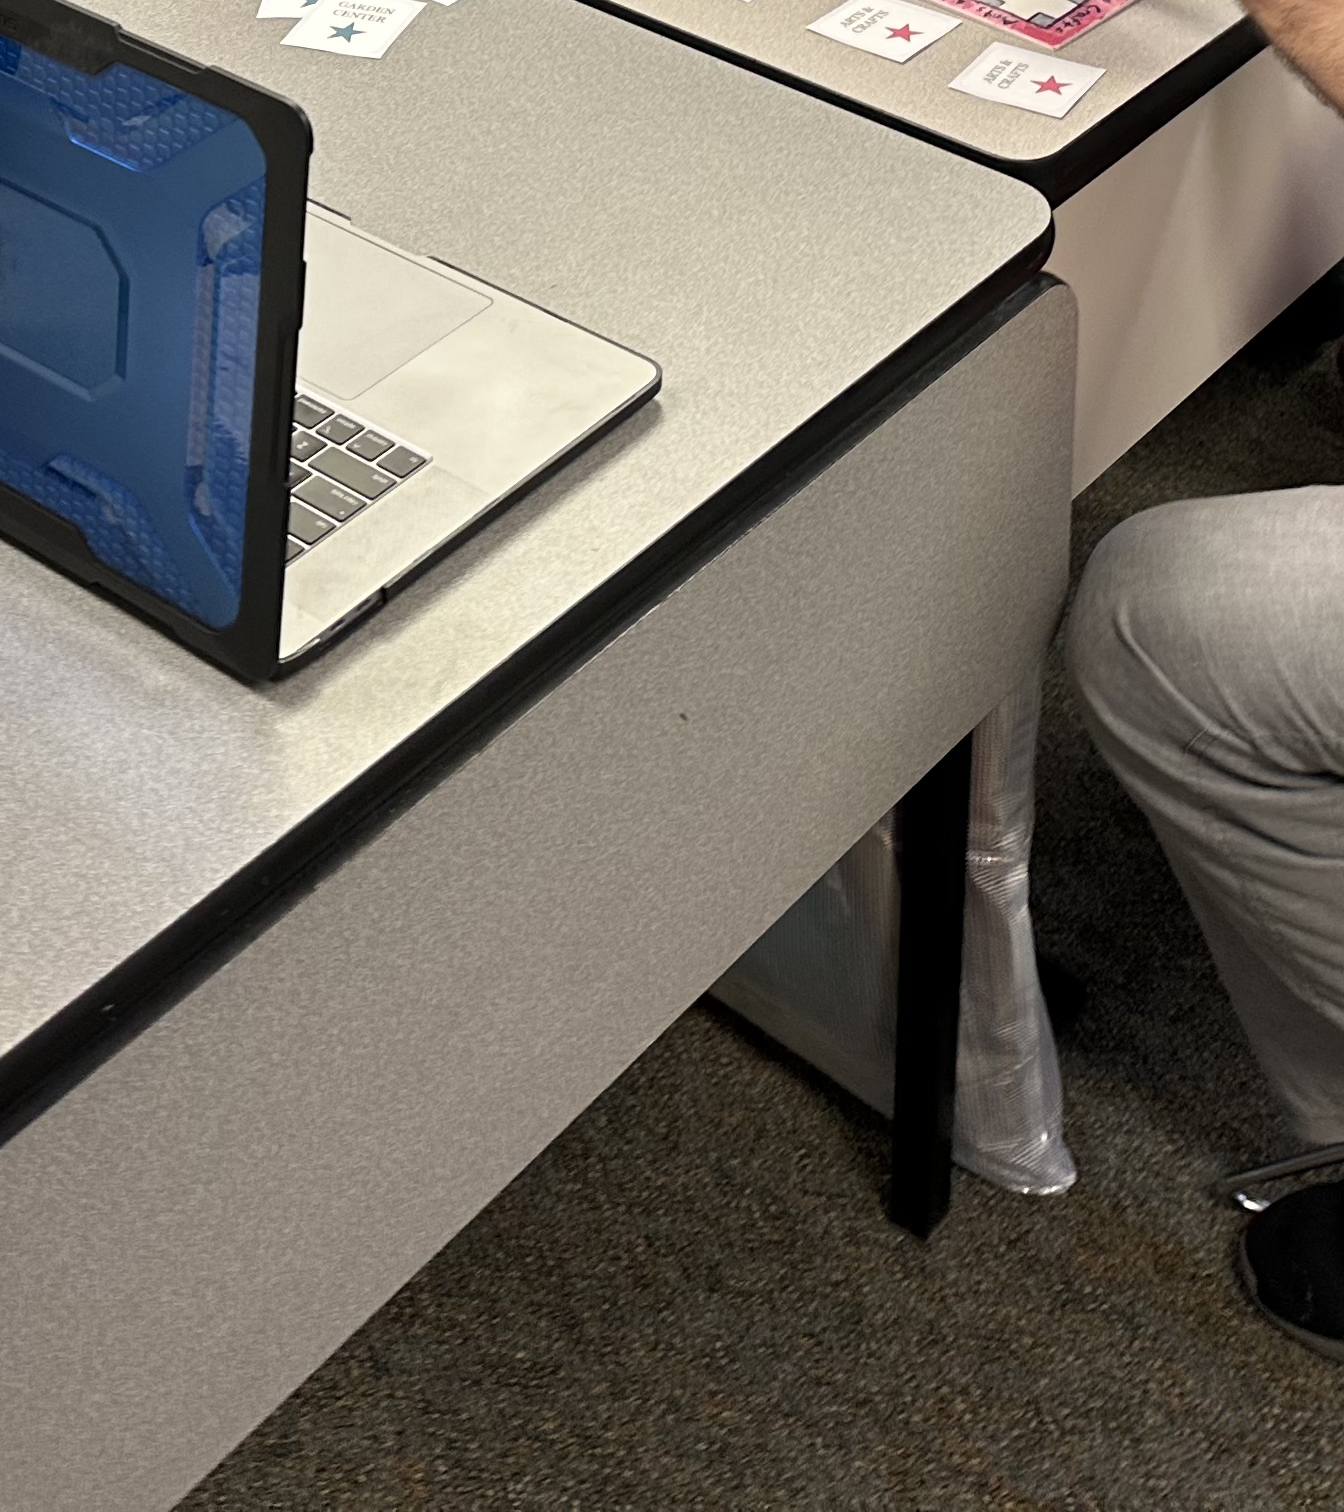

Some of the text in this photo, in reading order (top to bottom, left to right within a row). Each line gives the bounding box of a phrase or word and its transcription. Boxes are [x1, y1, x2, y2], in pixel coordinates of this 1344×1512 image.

[333, 9, 387, 23] CENTER
[338, 1, 396, 16] GARDEN
[840, 8, 866, 28] ARTS
[975, 6, 1019, 25] Arts
[851, 10, 889, 34] CRAFTS
[983, 63, 1006, 84] ARTS
[998, 62, 1030, 89] CRAFTS
